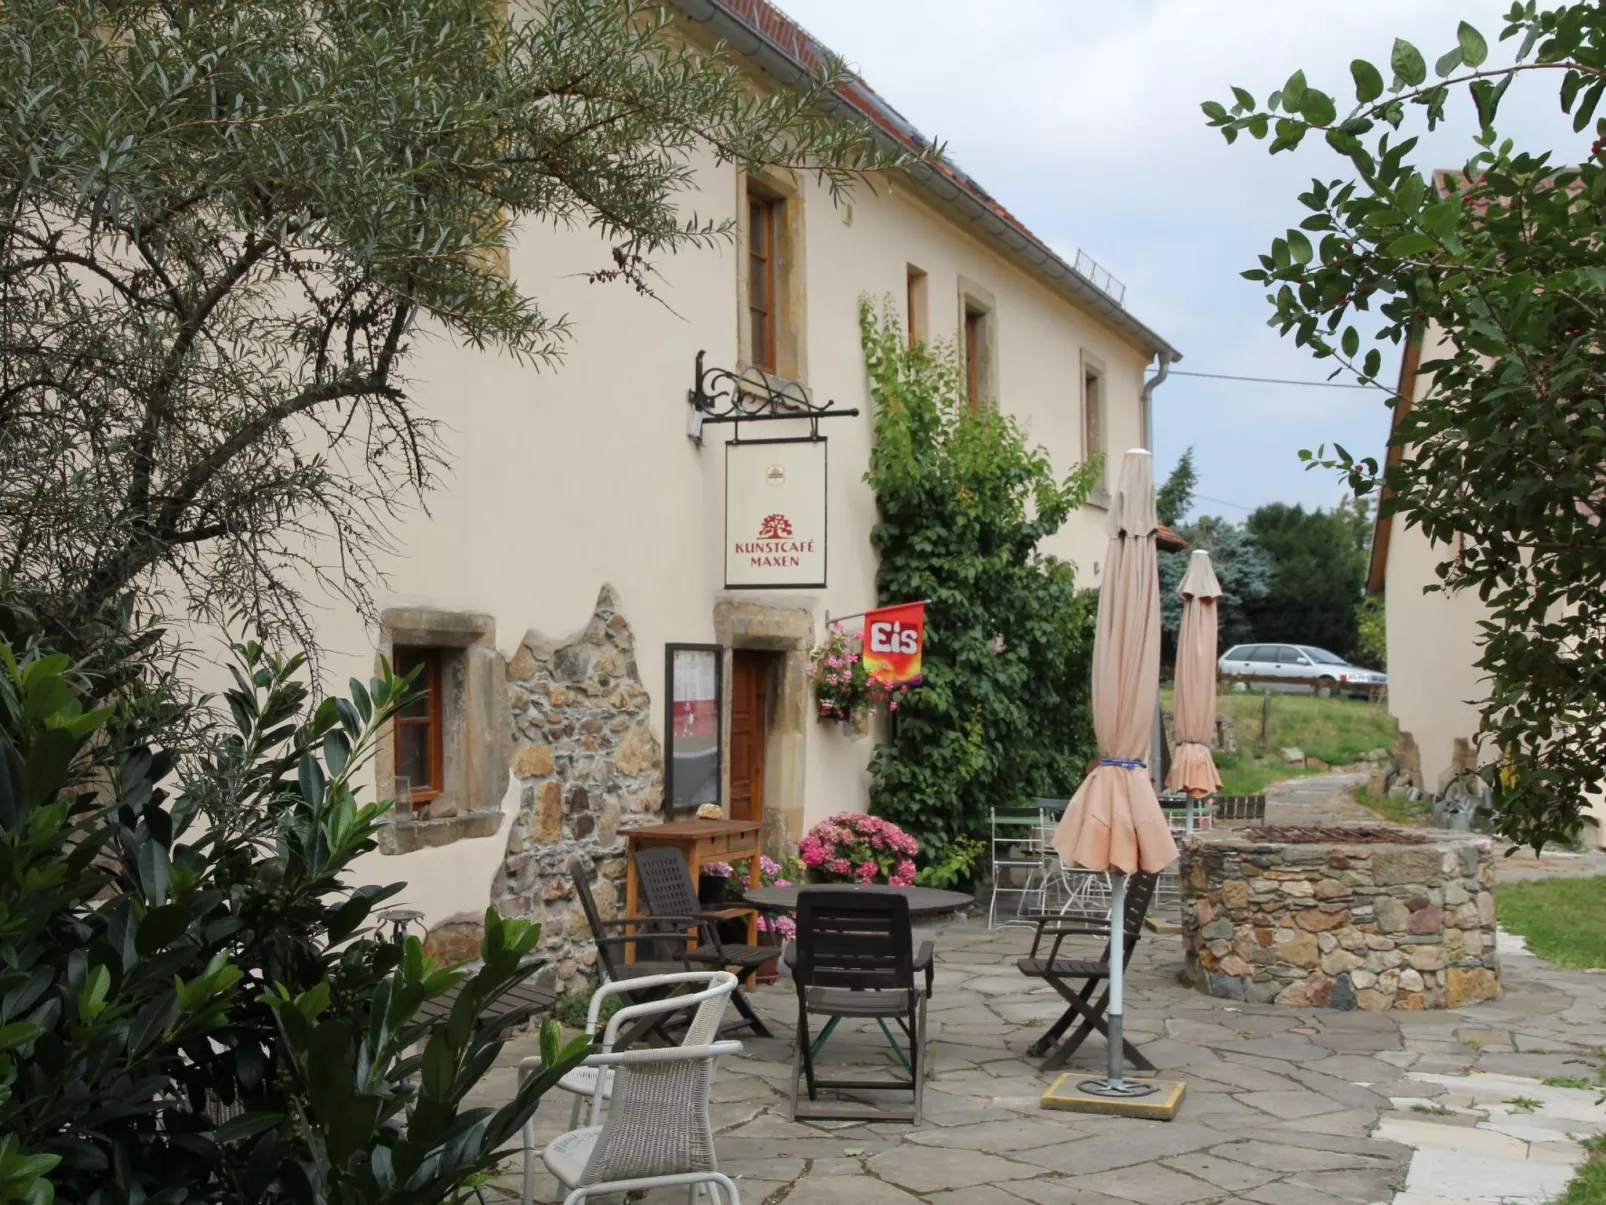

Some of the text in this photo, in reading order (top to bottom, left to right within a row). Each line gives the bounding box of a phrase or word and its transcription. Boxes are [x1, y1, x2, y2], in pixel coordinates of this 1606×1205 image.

[735, 538, 816, 554] KUNSTCAFÉ
[750, 556, 800, 568] MAXEN
[870, 620, 918, 655] Eis
